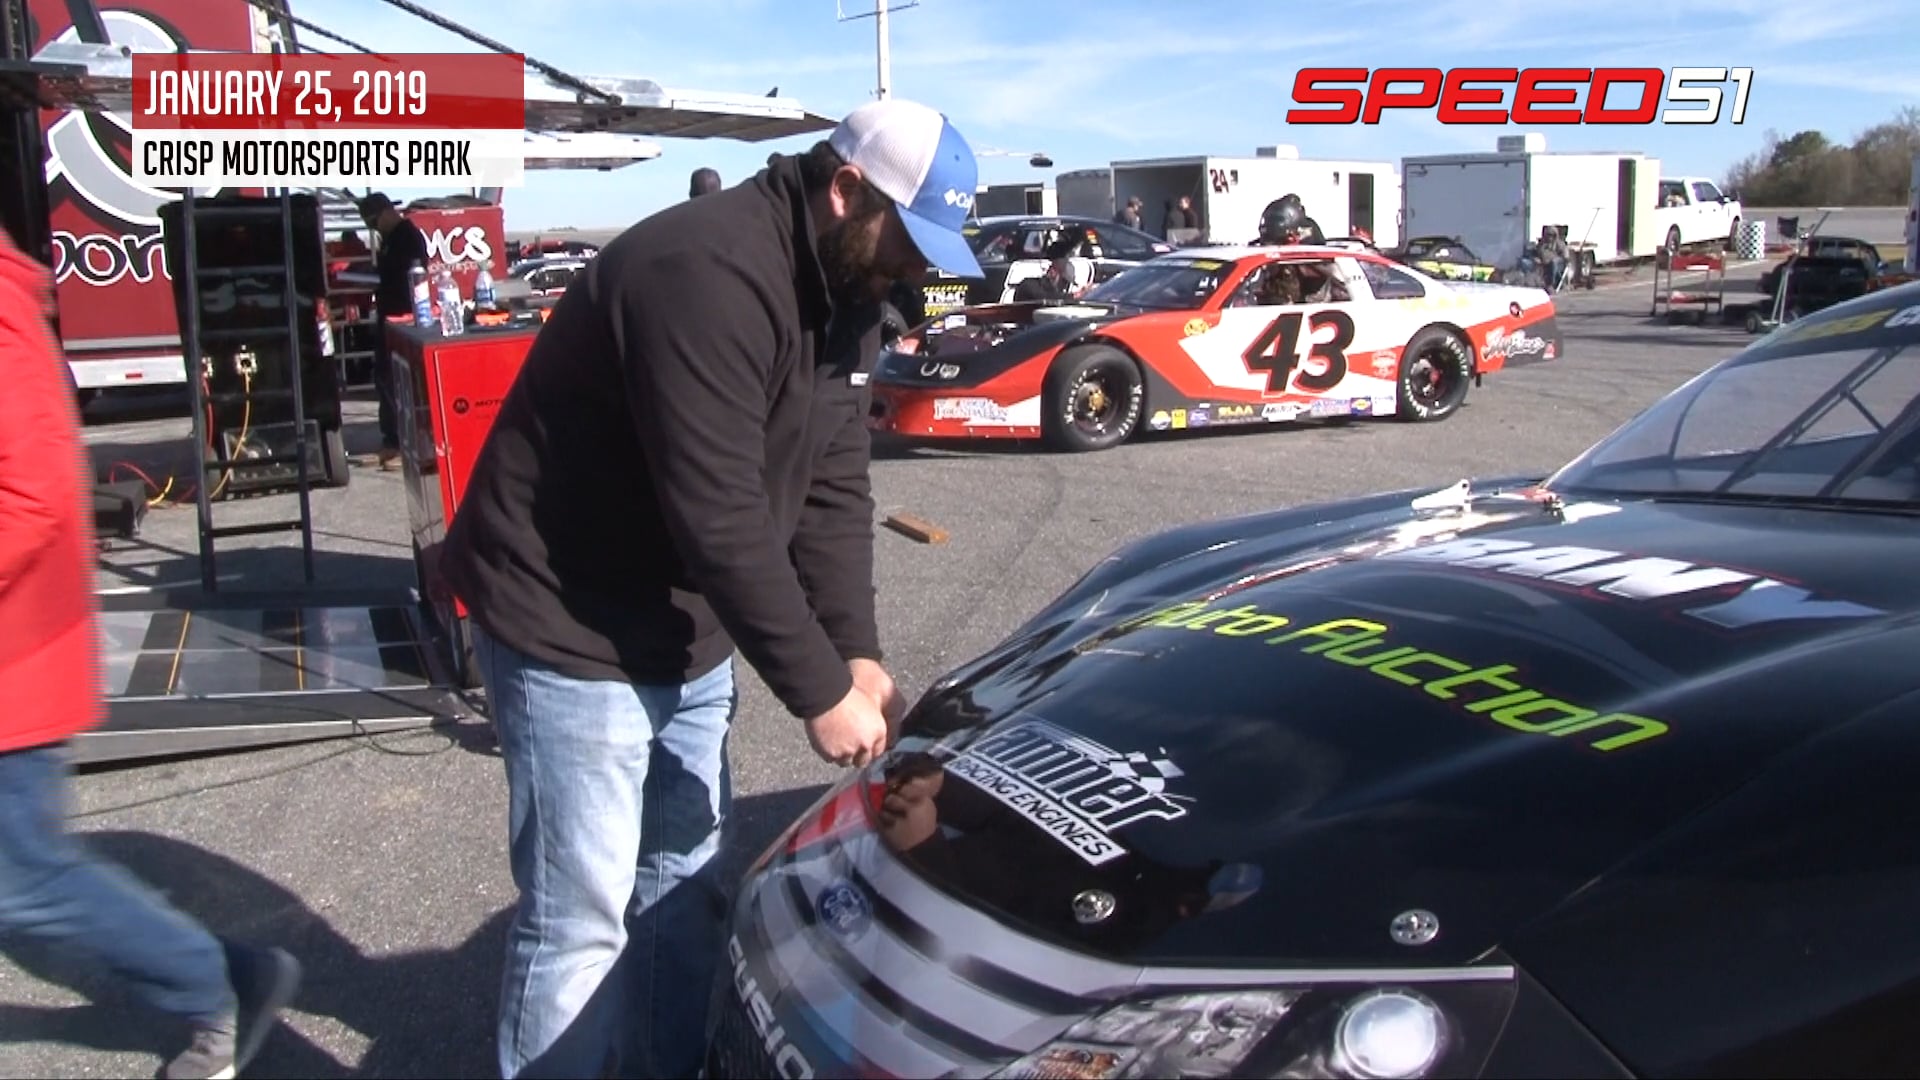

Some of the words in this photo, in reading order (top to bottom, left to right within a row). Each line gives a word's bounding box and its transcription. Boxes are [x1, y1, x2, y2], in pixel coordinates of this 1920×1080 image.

[1209, 168, 1230, 193] 24
[1242, 310, 1355, 396] 43
[1264, 617, 1671, 752] Auction
[953, 757, 1020, 797] RACING
[1012, 791, 1113, 857] ENGINES
[966, 720, 1188, 834] amner
[727, 933, 816, 1080] FUSIO
